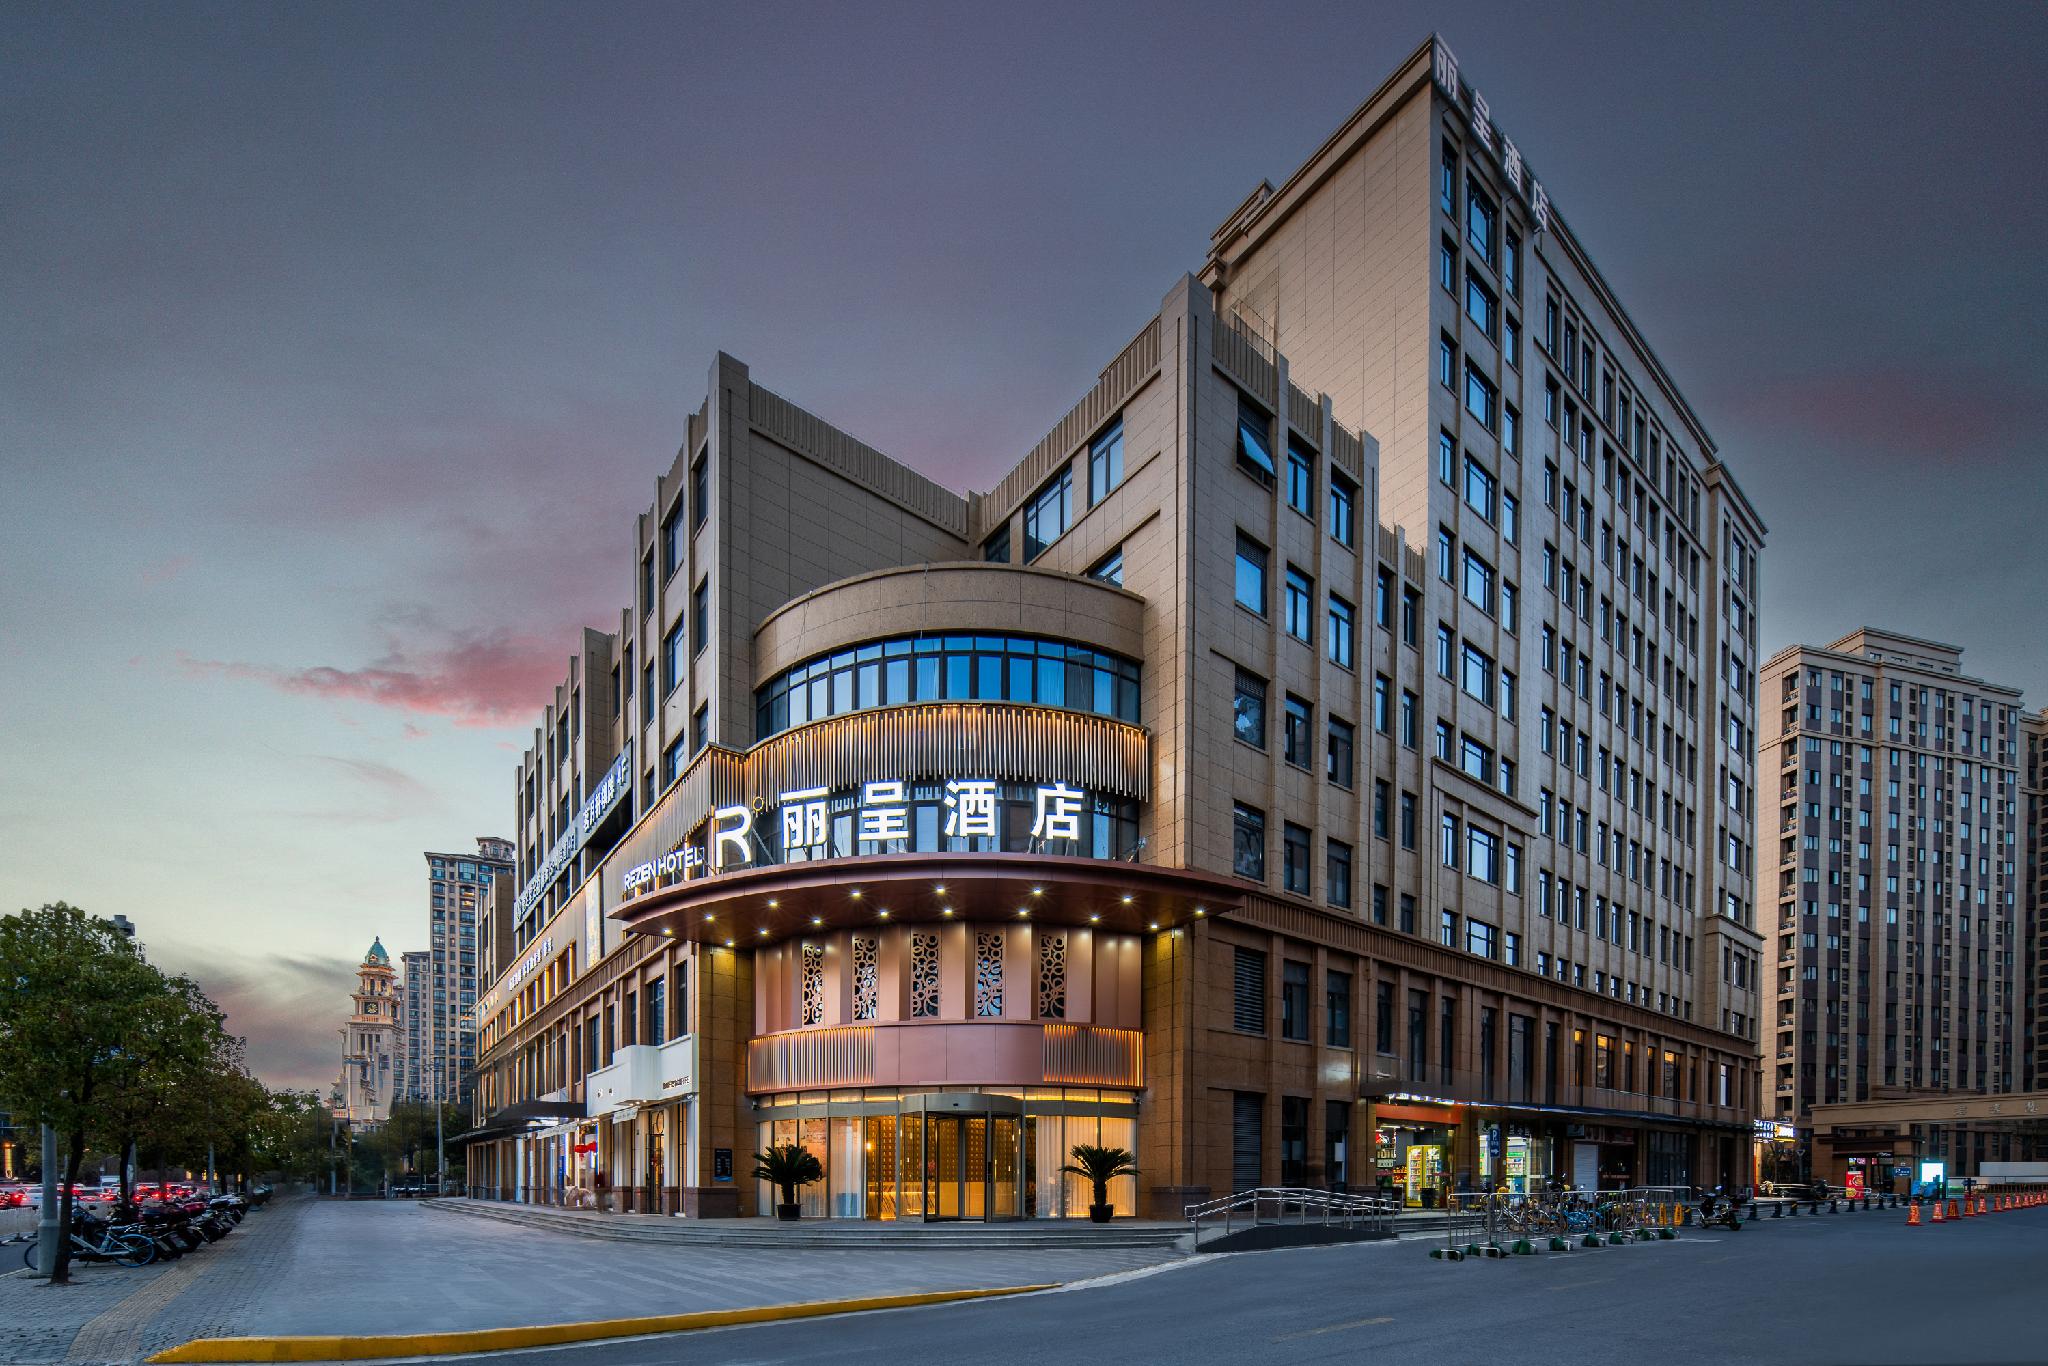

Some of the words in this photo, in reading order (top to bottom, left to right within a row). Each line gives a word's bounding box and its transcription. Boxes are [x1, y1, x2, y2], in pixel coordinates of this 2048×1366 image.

[1435, 32, 1549, 232] 丽呈酒店
[714, 804, 752, 868] R
[780, 779, 1084, 850] 丽呈酒店
[623, 860, 657, 892] REZEN
[657, 846, 704, 877] HOTEL
